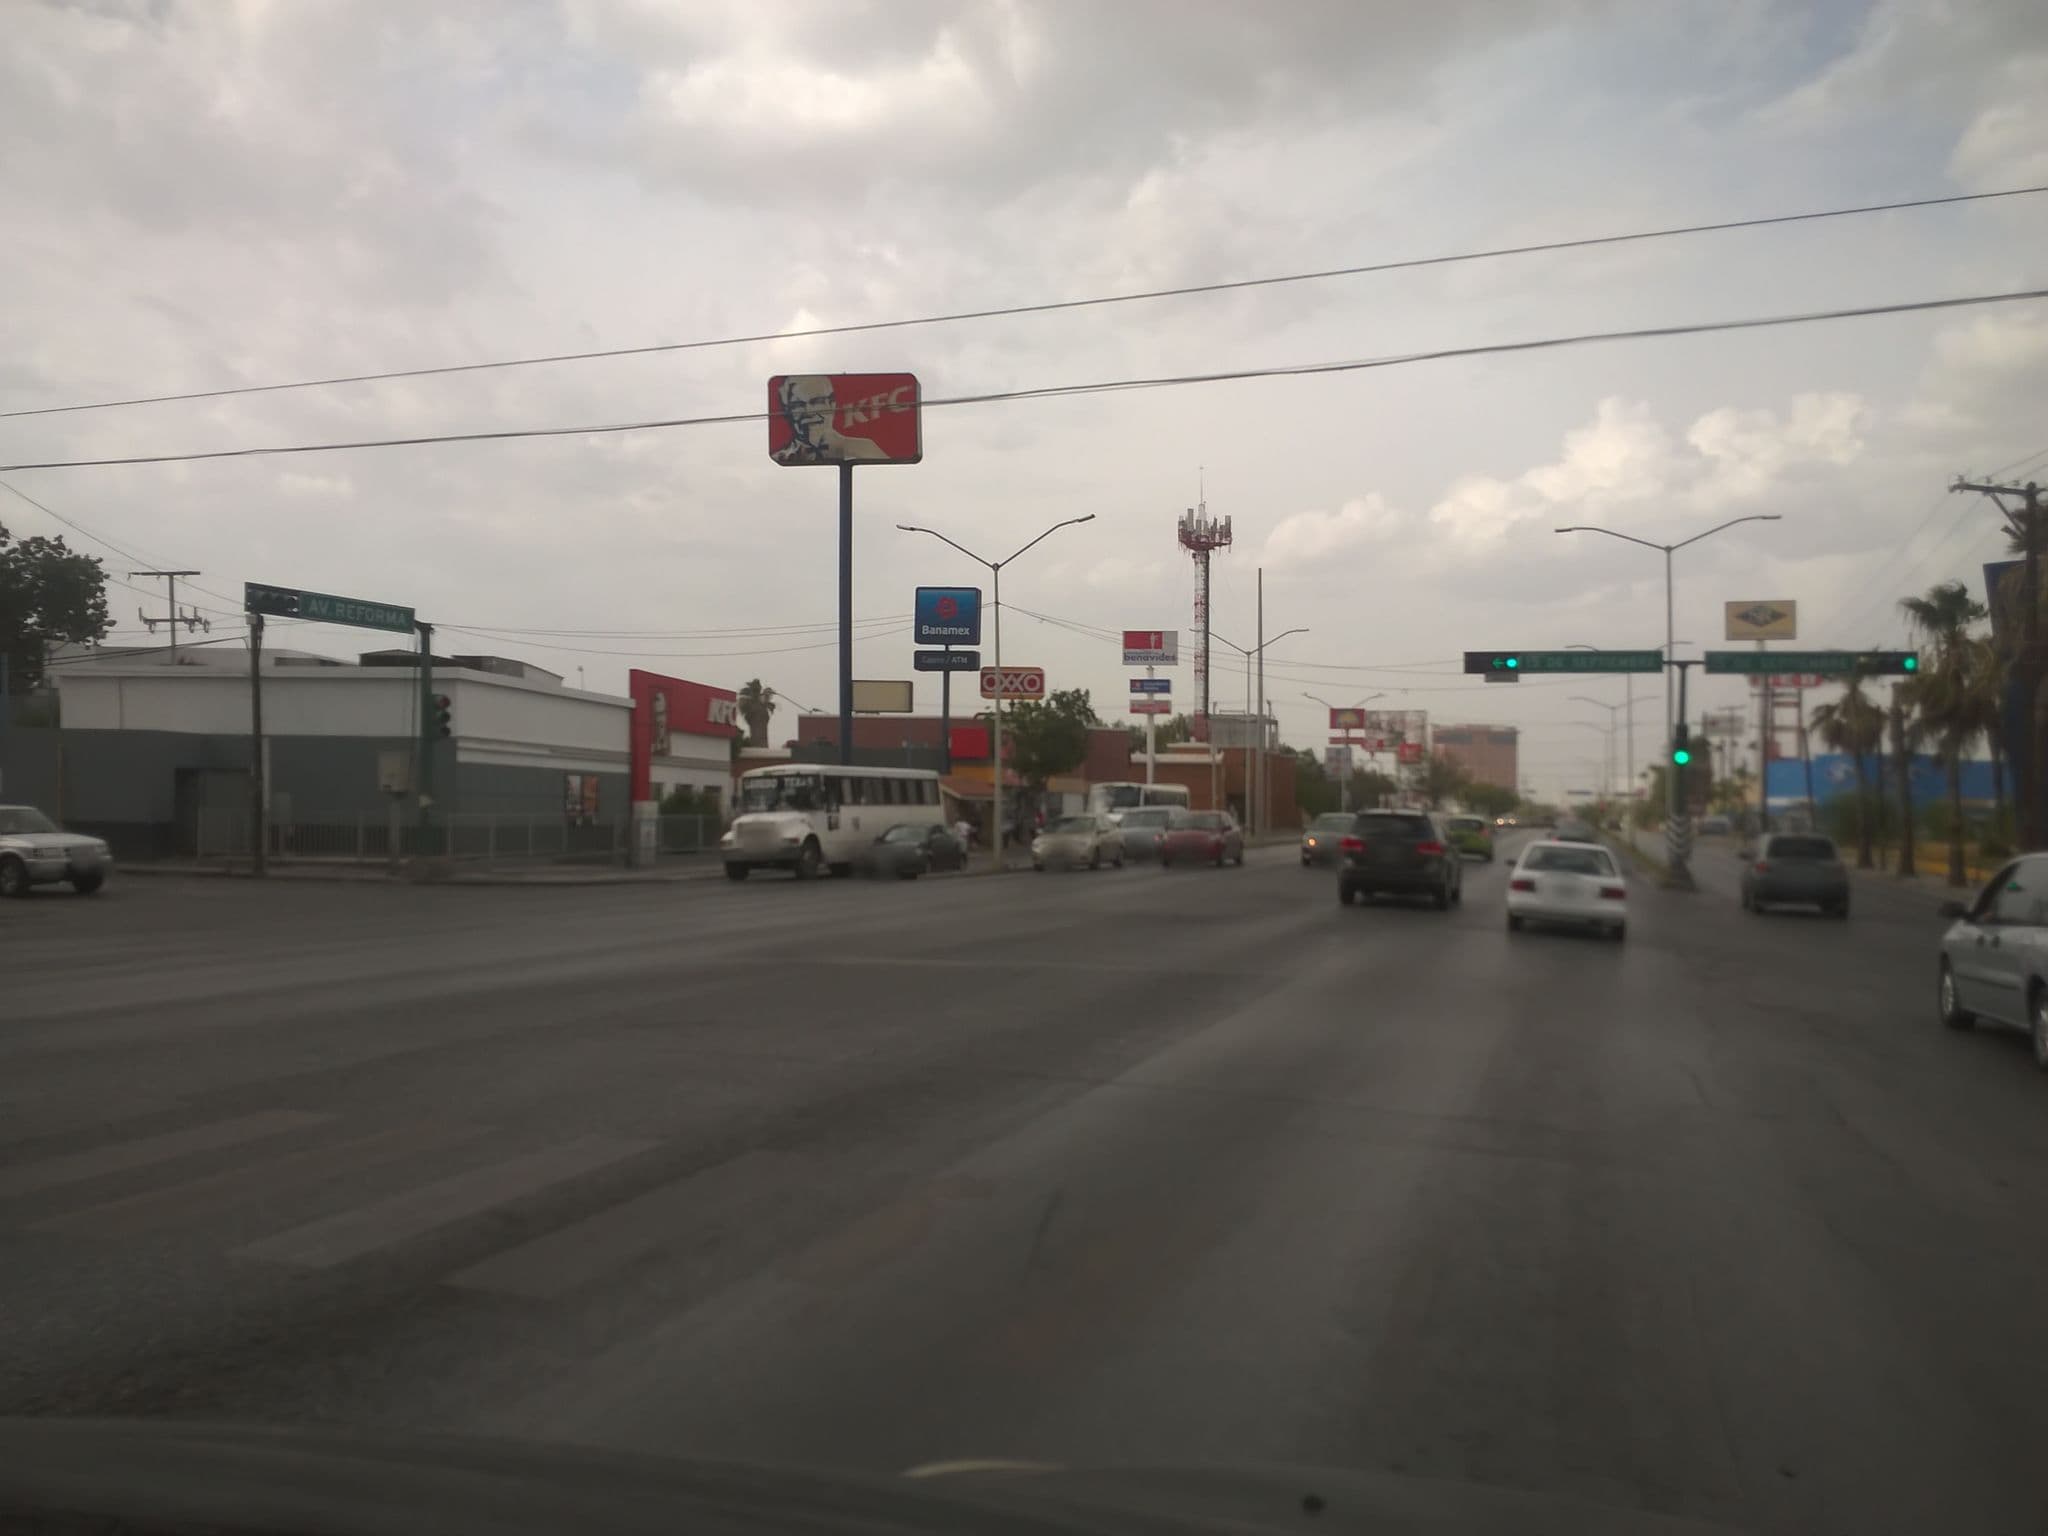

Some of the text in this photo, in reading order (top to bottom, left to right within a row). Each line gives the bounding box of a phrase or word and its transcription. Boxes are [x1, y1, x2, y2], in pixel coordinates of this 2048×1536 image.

[844, 385, 913, 429] KFC
[335, 603, 408, 624] REFORMA
[921, 625, 971, 636] Banamex
[951, 656, 968, 664] ATM
[1124, 652, 1175, 662] benavides
[983, 674, 1041, 692] OXXO
[708, 697, 737, 726] KFC
